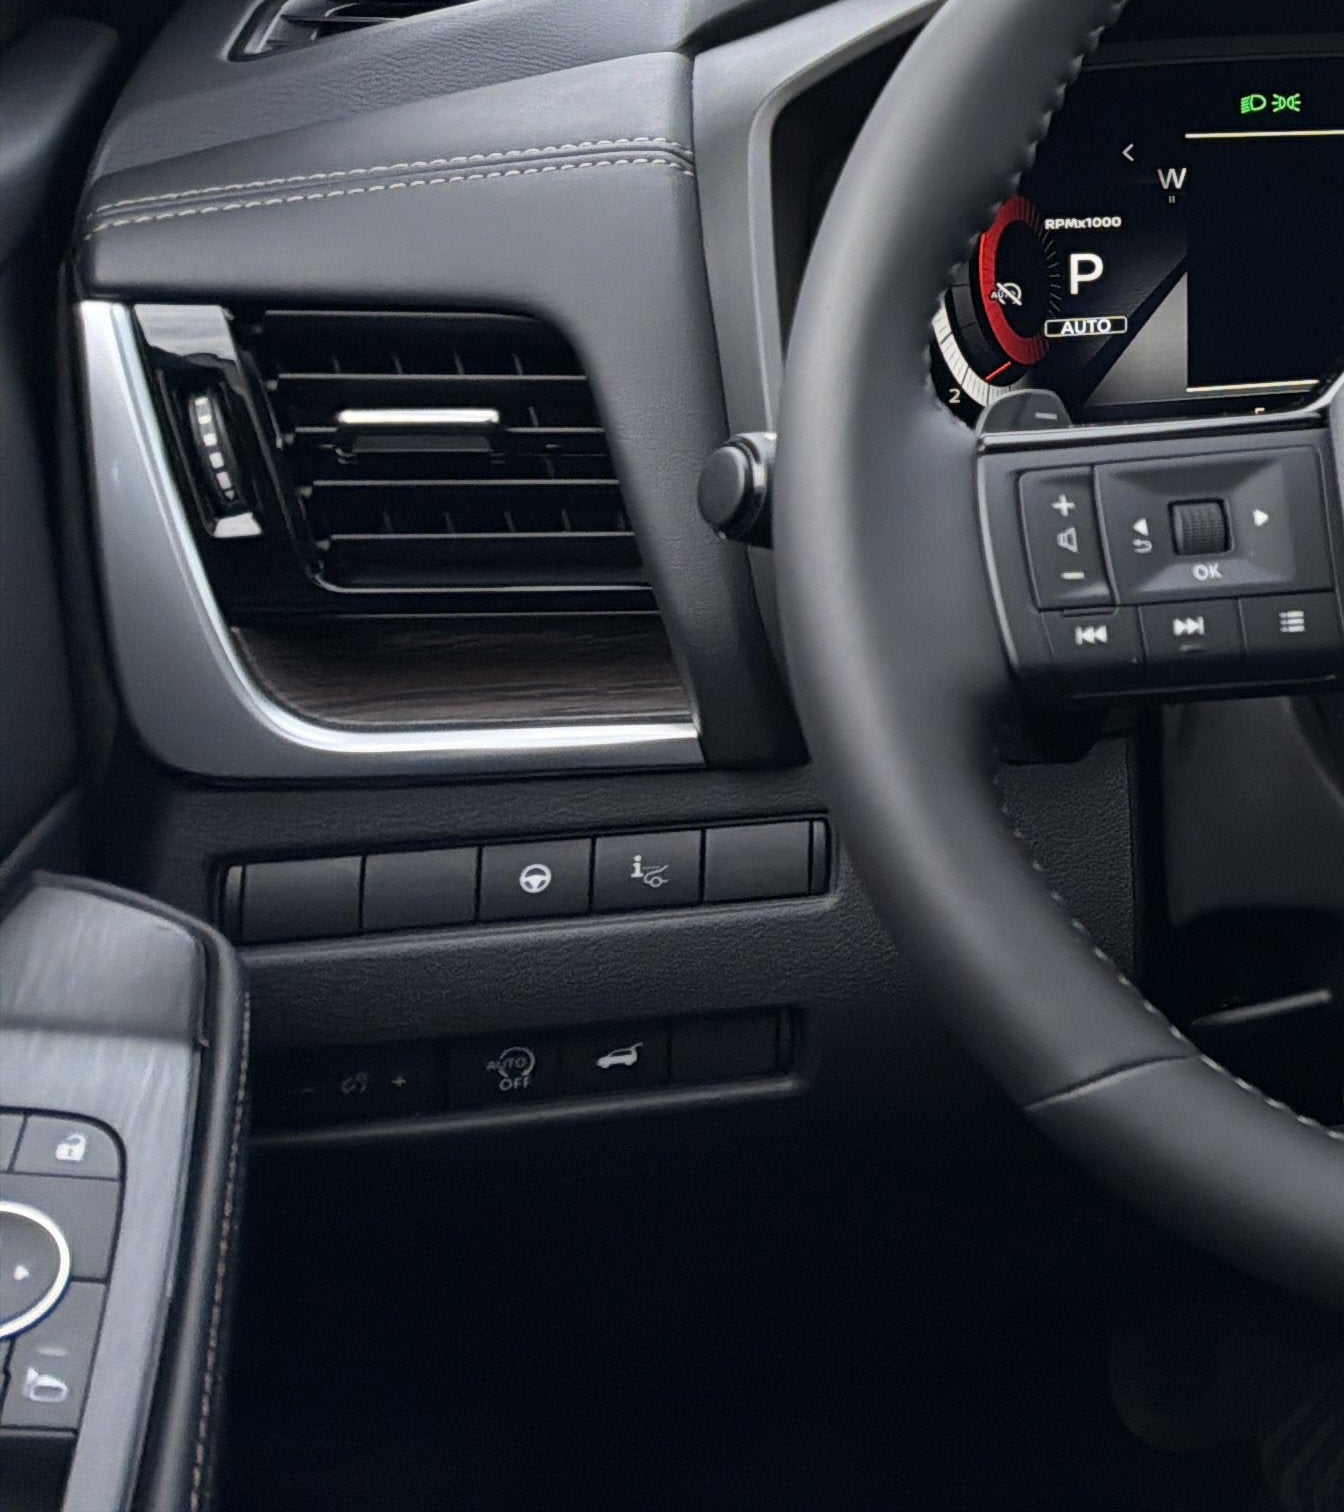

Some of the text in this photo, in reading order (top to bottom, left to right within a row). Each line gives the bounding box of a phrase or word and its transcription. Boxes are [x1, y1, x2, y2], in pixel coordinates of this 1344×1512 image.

[1157, 167, 1187, 189] W
[1044, 216, 1122, 230] RPMx1000
[1069, 253, 1104, 295] P
[1061, 318, 1112, 335] AUTO
[948, 389, 961, 404] 2
[1193, 563, 1222, 580] OK
[499, 1077, 531, 1091] OFF
